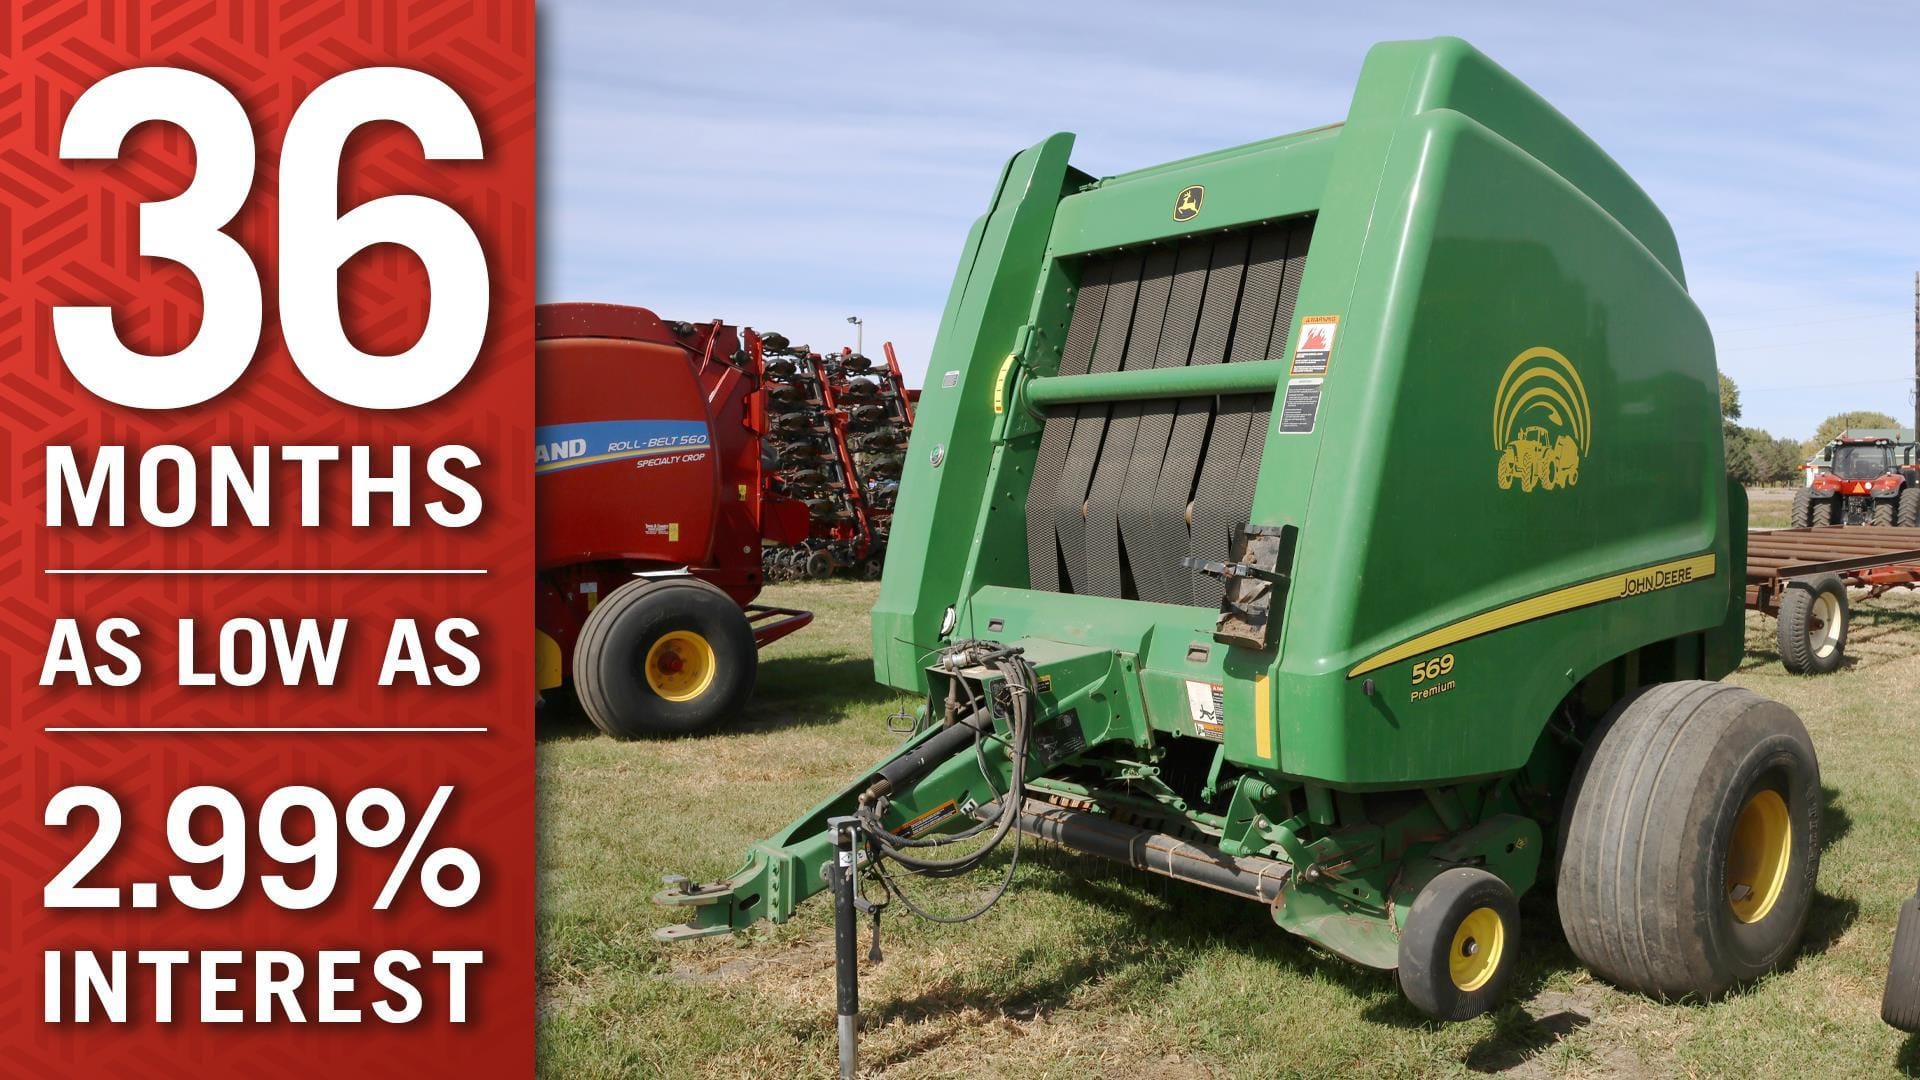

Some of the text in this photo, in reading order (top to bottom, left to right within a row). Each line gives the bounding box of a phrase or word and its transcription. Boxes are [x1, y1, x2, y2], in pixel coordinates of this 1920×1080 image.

[608, 434, 707, 452] ROLL-BELT 560
[637, 453, 705, 468] SPECIALTY CROP
[1621, 567, 1692, 596] JOHN DEERE
[1412, 653, 1455, 685] 569
[1410, 680, 1456, 703] Premium
